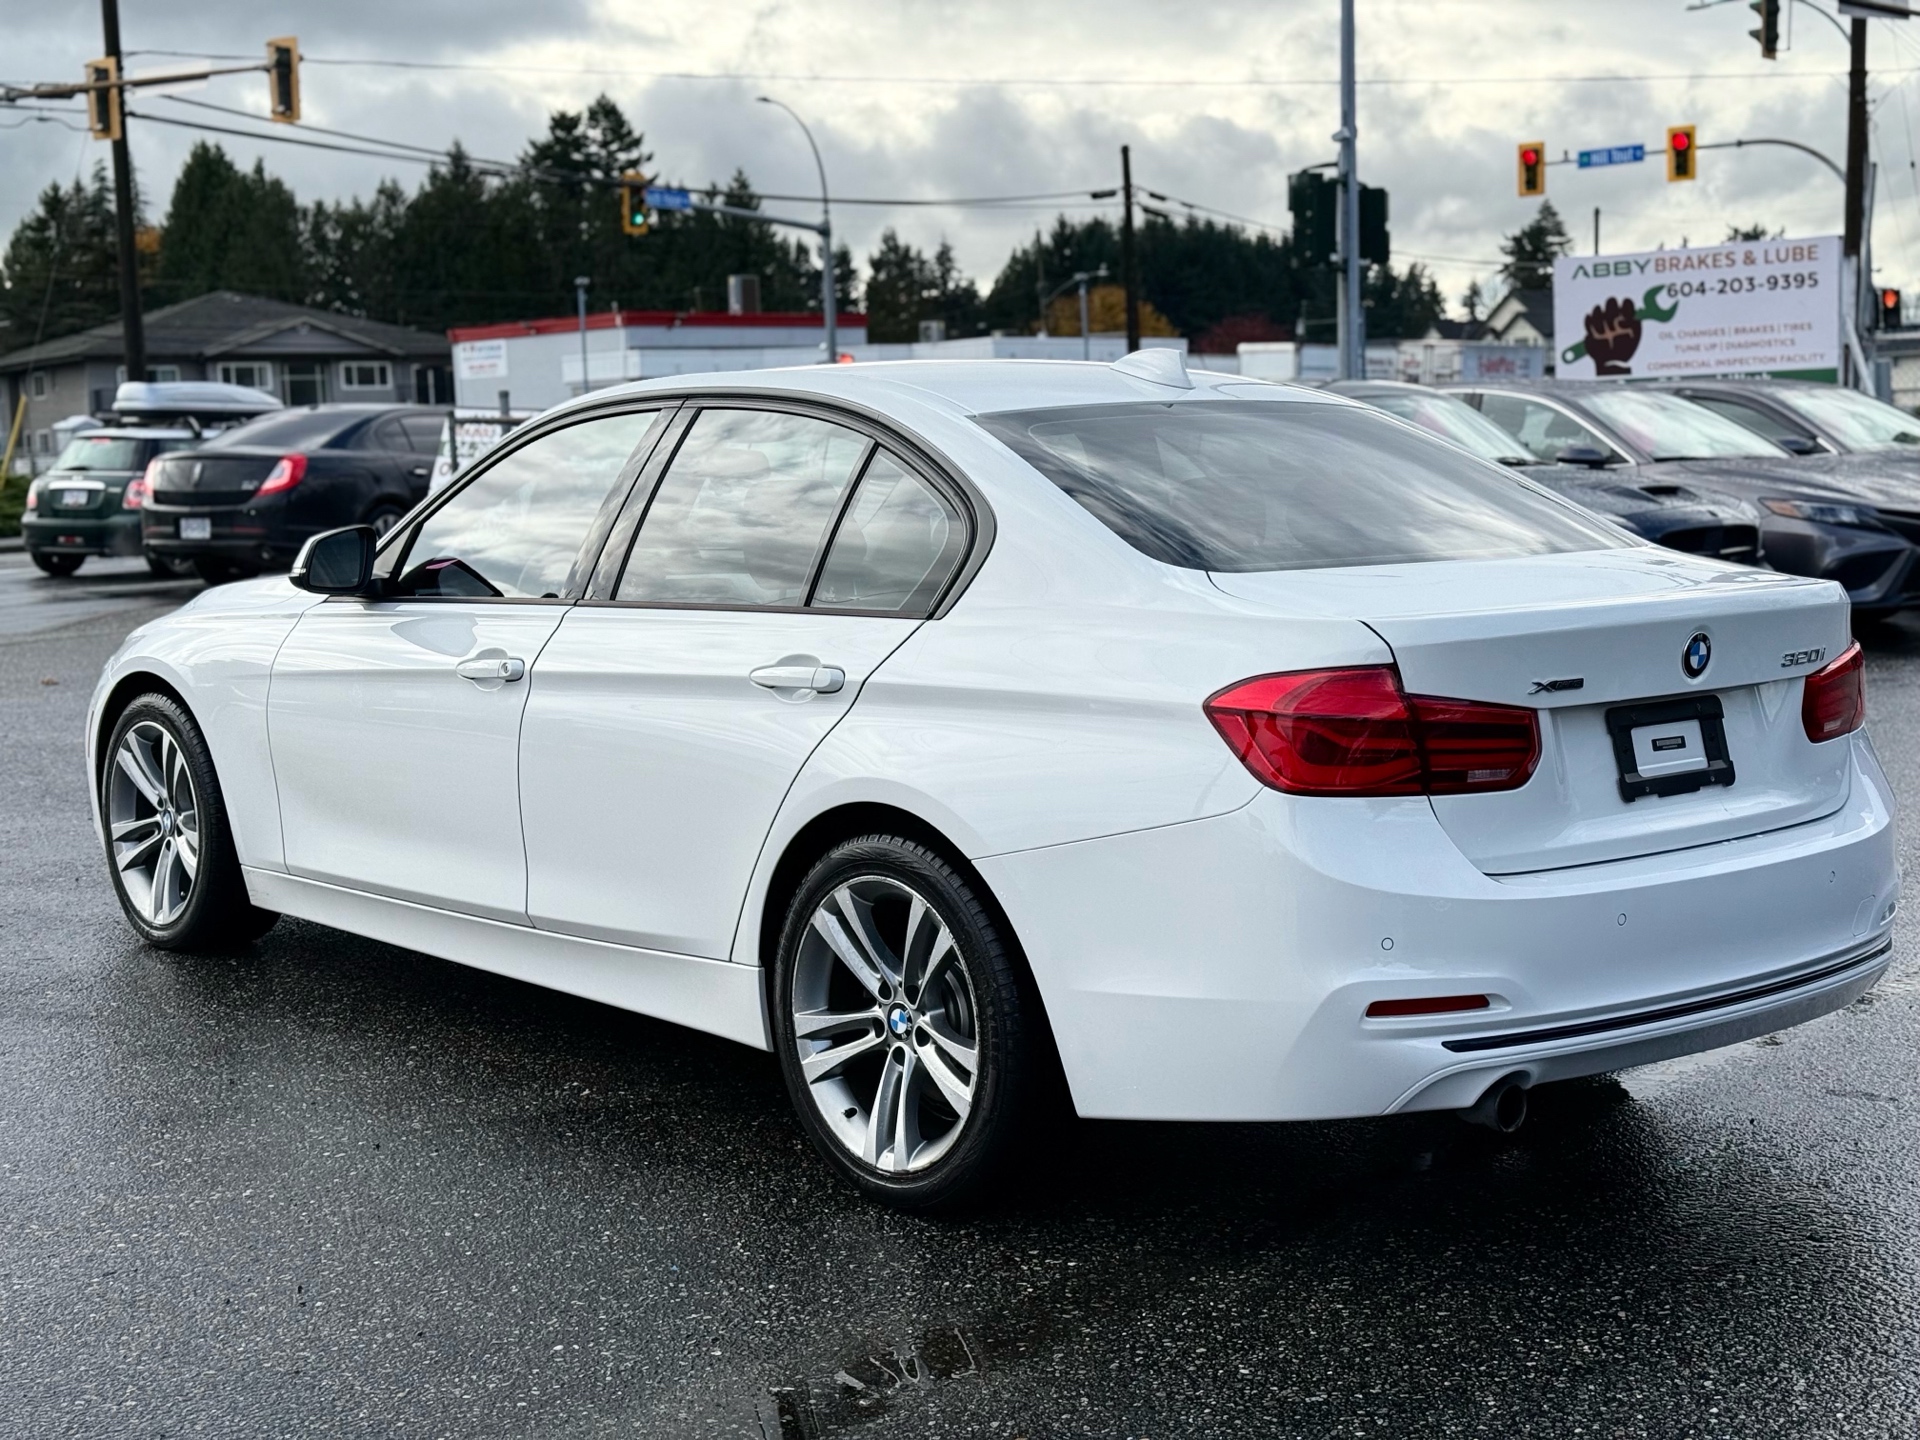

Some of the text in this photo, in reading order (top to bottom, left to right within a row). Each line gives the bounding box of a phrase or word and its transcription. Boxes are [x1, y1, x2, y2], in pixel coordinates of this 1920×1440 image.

[1572, 244, 1819, 280] ABBY BRAKES & LUBE
[1667, 271, 1819, 299] 604-203-9395
[1658, 322, 1813, 340] OIL CHANGES BRAKES TIRES
[1675, 338, 1796, 353] TUNE UP DIAGNOSTICS
[1647, 352, 1826, 372] COMMERCIAL INSPECTION FACILITY
[1781, 645, 1826, 668] 320i
